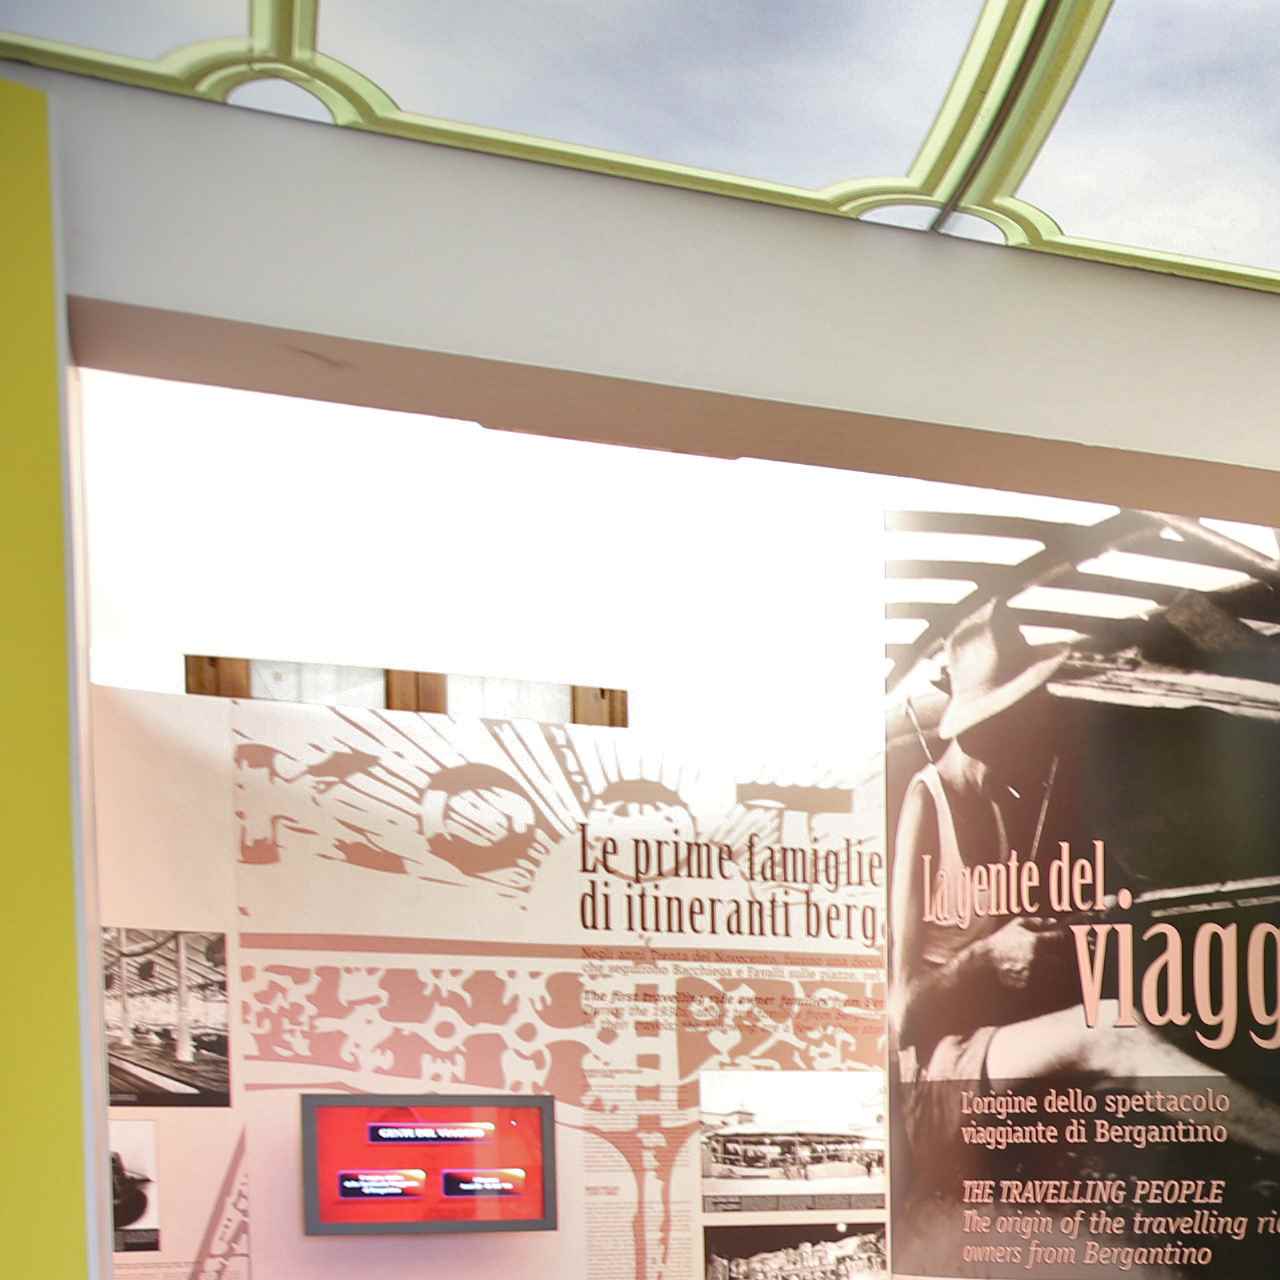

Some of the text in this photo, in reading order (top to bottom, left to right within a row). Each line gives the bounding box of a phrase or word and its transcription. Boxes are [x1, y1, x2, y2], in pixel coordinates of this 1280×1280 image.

[578, 822, 883, 893] Le prime famiglie
[921, 840, 1109, 929] La gente del
[580, 880, 885, 949] di itineranti berg
[1044, 1089, 1097, 1113] dello
[1104, 1088, 1230, 1118] spettacolo
[961, 1120, 1228, 1149] viaggiante di Bergantino
[962, 1180, 1226, 1204] THE TRAVELLING PEOPLE
[962, 1209, 991, 1234] The
[995, 1211, 1053, 1240] origin
[1060, 1210, 1086, 1239] of
[1089, 1210, 1126, 1235] the
[1133, 1210, 1249, 1240] travelling
[962, 1240, 1213, 1271] owners from Bergantino
